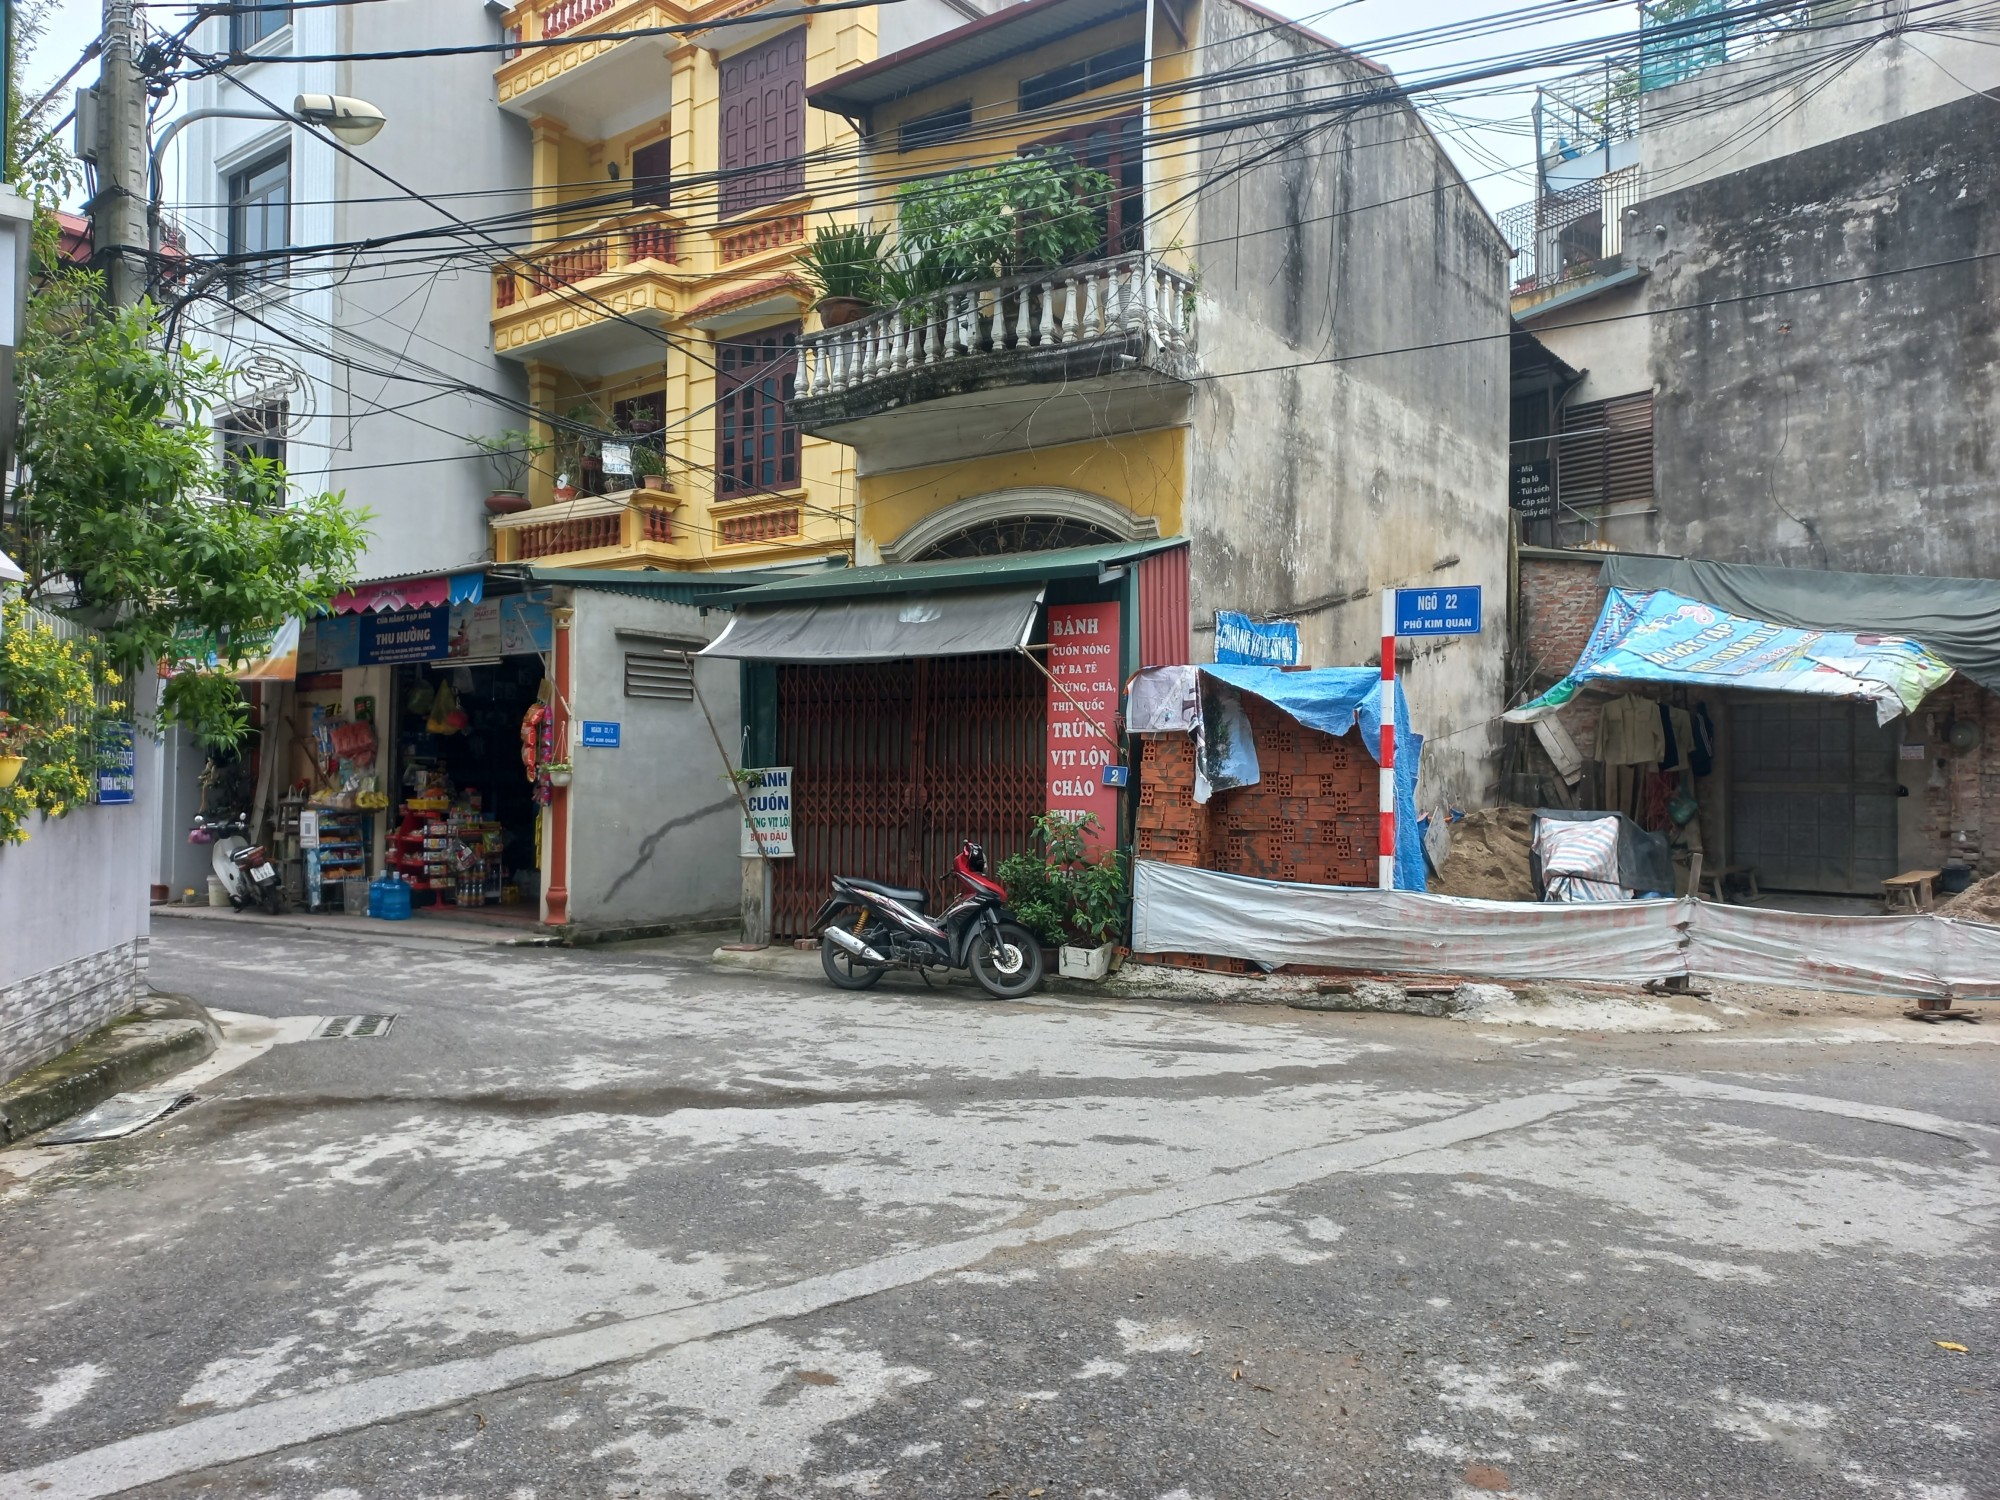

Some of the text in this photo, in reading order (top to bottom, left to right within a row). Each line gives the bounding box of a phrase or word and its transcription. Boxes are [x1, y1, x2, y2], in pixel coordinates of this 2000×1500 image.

[1521, 474, 1539, 484] Ba lô
[1417, 591, 1458, 611] NGÕ 22
[1053, 614, 1099, 636] BÁNH
[1403, 616, 1472, 629] PHỐ KIM QUAN
[375, 632, 395, 646] THU
[1052, 641, 1111, 656] CUỐN NÓNG
[1068, 664, 1083, 674] BA
[1084, 660, 1098, 674] TÊ
[1052, 717, 1107, 738] TRỨNG
[1050, 744, 1111, 770] VỊT LỘN
[1110, 768, 1119, 782] 2
[1051, 775, 1095, 797] CHÁO
[748, 790, 789, 812] CUỐN
[768, 816, 779, 830] VỊT
[770, 830, 788, 843] ĐẬU
